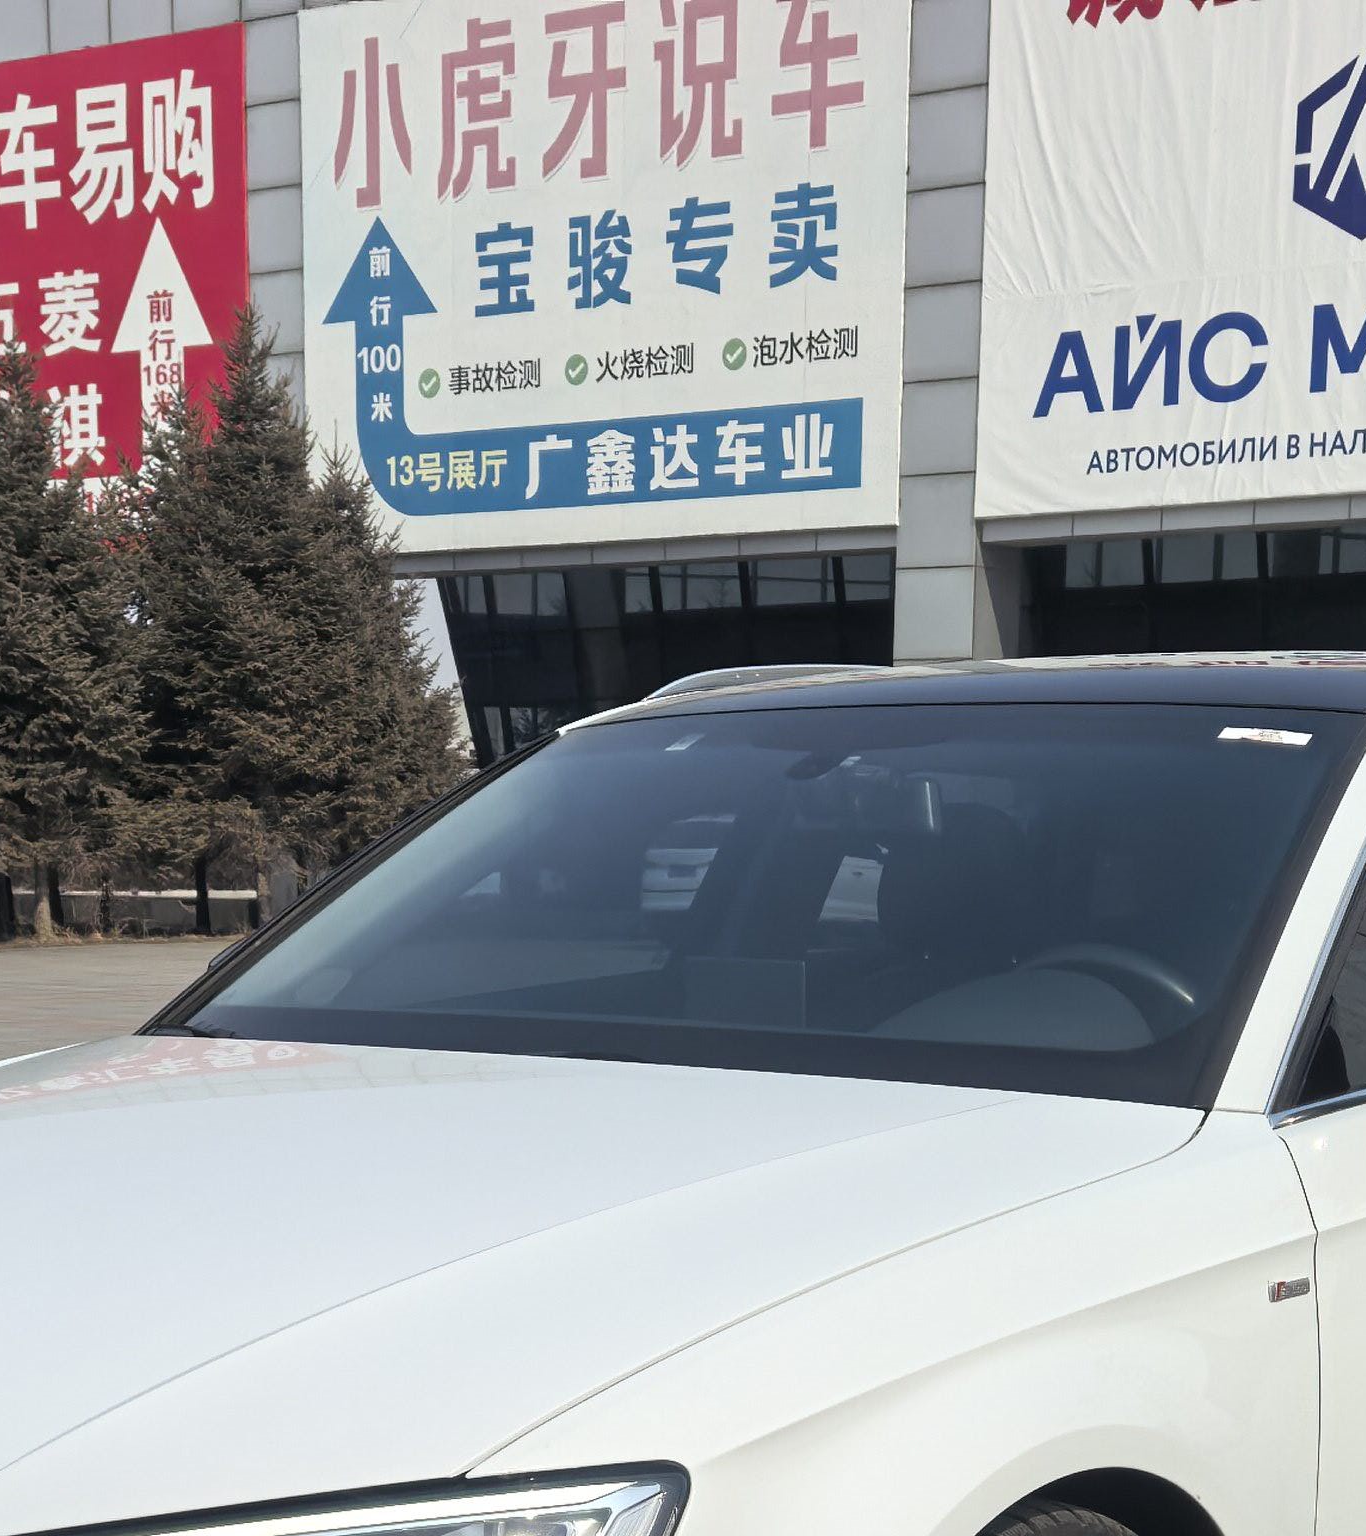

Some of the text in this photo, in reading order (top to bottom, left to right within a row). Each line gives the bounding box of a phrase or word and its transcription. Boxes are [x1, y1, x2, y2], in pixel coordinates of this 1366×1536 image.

[334, 0, 865, 209] 小虎牙说车
[474, 182, 839, 318] 宝骏专卖
[448, 325, 859, 396] 事故检测 火烧检测 泡水检测
[1032, 311, 1270, 418] АЙС
[386, 412, 835, 500] 13号展厅 广鑫达车业
[1086, 434, 1279, 475] АВТОМОБИЛИ
[1285, 436, 1301, 460] В
